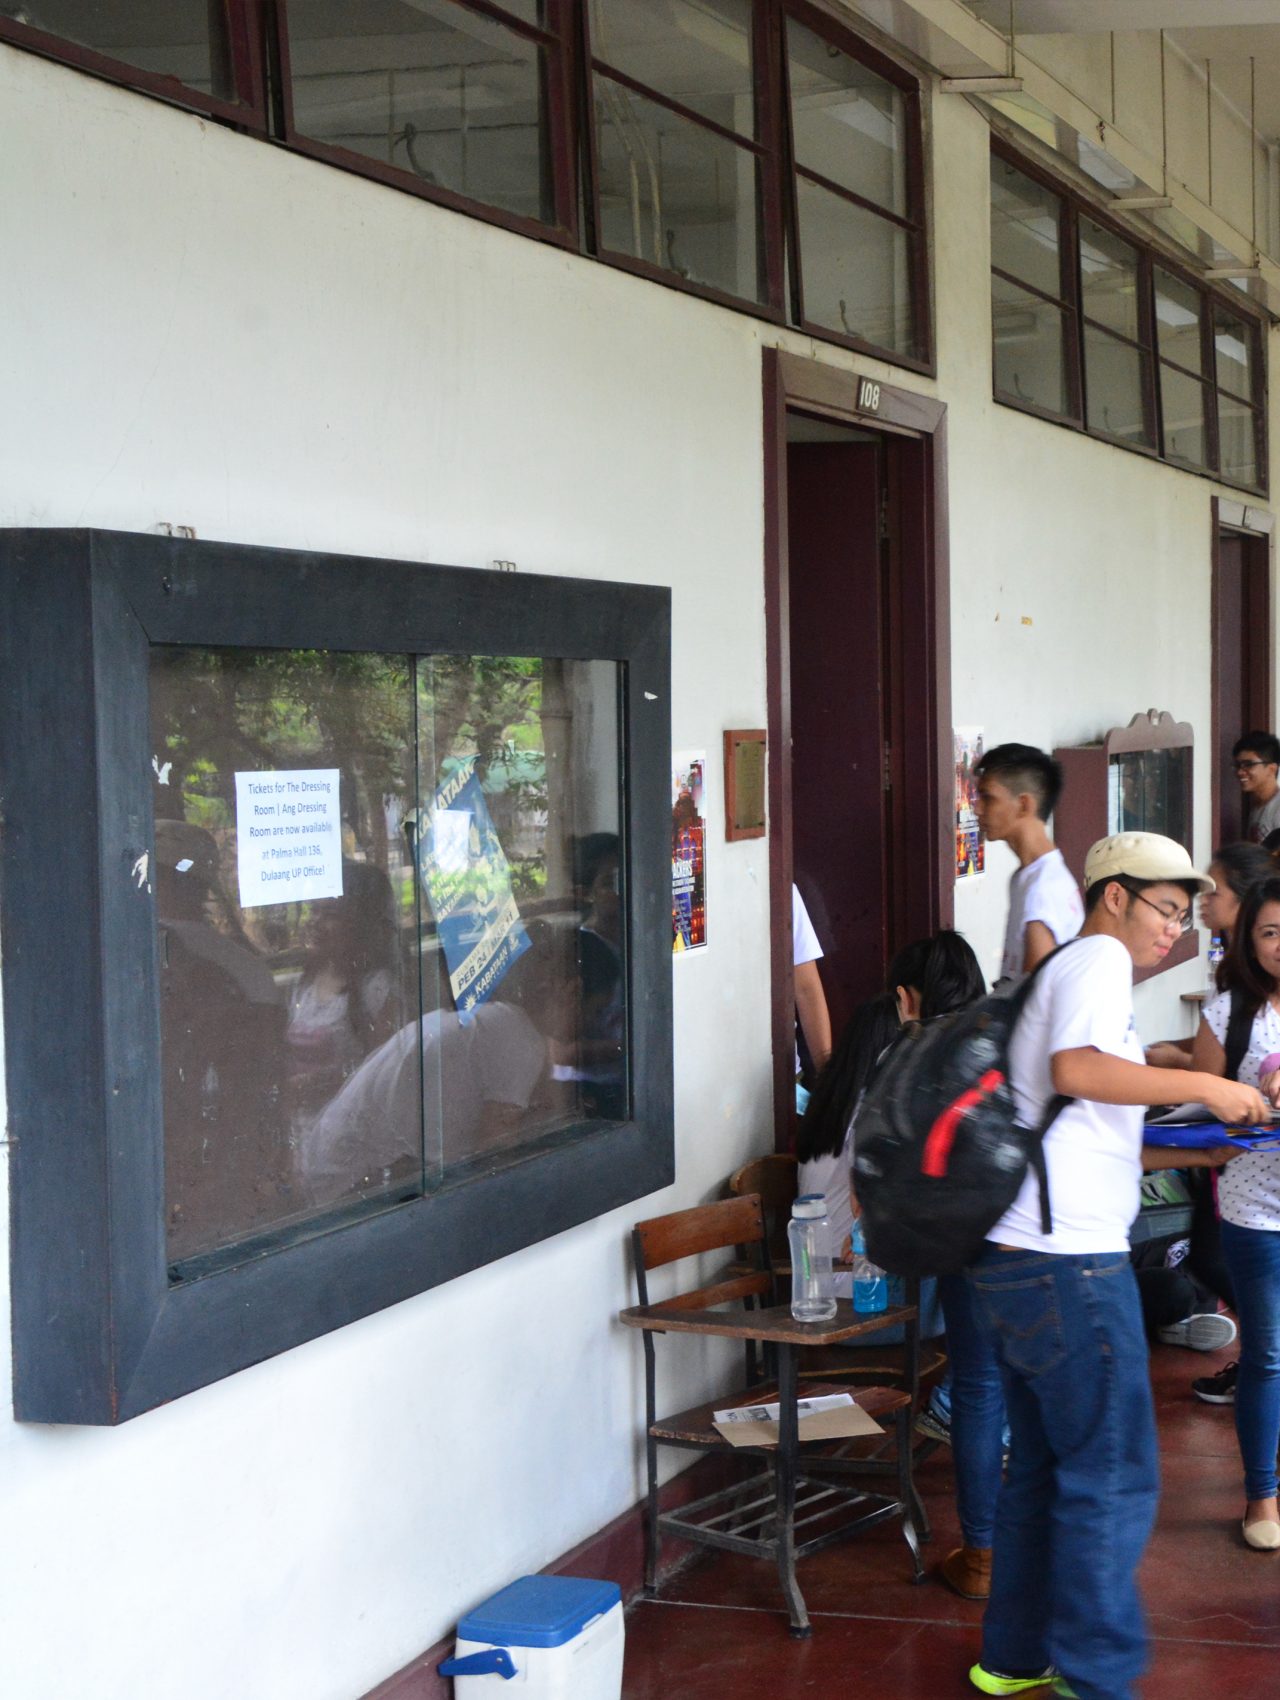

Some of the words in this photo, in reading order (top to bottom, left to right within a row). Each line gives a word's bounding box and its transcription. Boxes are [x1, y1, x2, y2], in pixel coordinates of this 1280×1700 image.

[860, 381, 880, 410] 108
[248, 783, 274, 794] Tickets
[275, 782, 285, 793] for
[287, 782, 300, 792] The
[301, 780, 331, 793] Dressing
[254, 804, 275, 816] Room
[282, 803, 296, 816] Ang
[297, 802, 327, 814] Dressing
[249, 826, 272, 838] Room
[272, 827, 284, 836] are
[285, 825, 300, 835] now
[301, 821, 333, 834] available
[261, 850, 270, 860] at
[271, 847, 293, 859] Palma
[293, 846, 307, 857] Hall
[261, 869, 290, 881] Dulaang
[291, 868, 302, 879] UP
[458, 965, 476, 990] PEB
